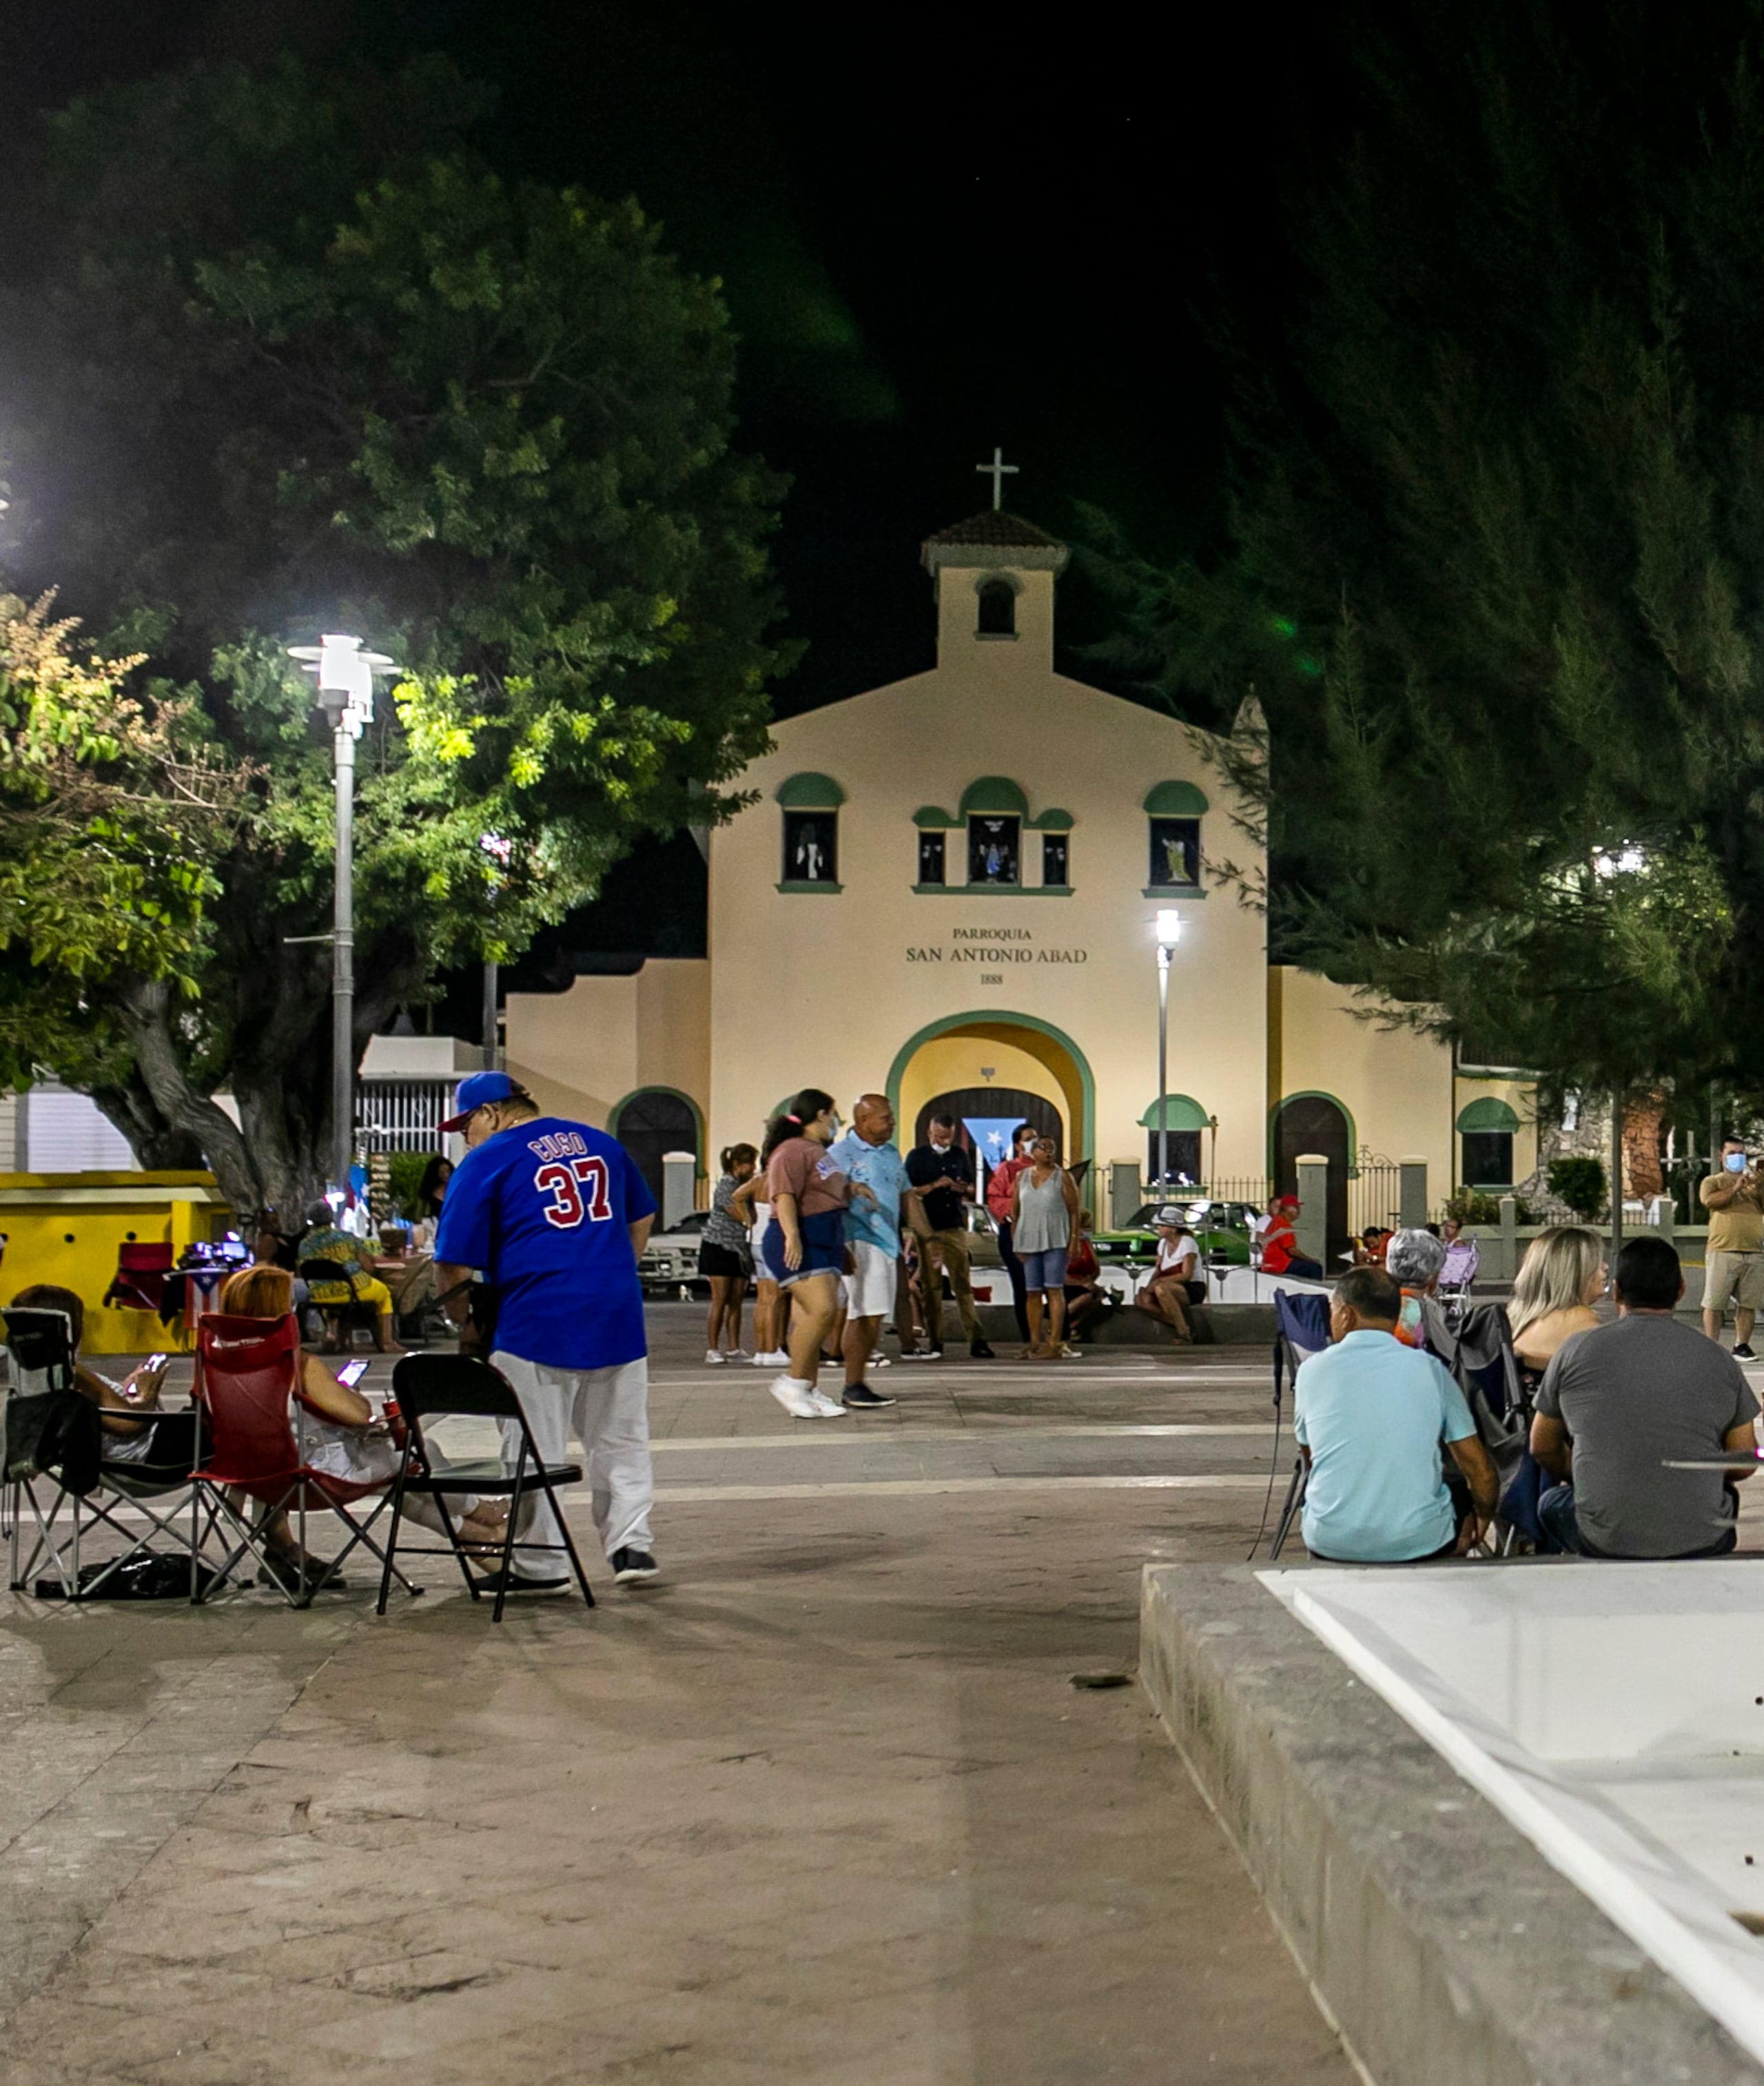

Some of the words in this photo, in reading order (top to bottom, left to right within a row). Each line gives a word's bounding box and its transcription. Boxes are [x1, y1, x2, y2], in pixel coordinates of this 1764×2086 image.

[953, 928, 1032, 941] PARROQUIA
[906, 948, 942, 962] SAN
[950, 948, 1032, 963] ANTONIO
[1037, 950, 1087, 963] ABAD
[533, 1155, 613, 1229] 37
